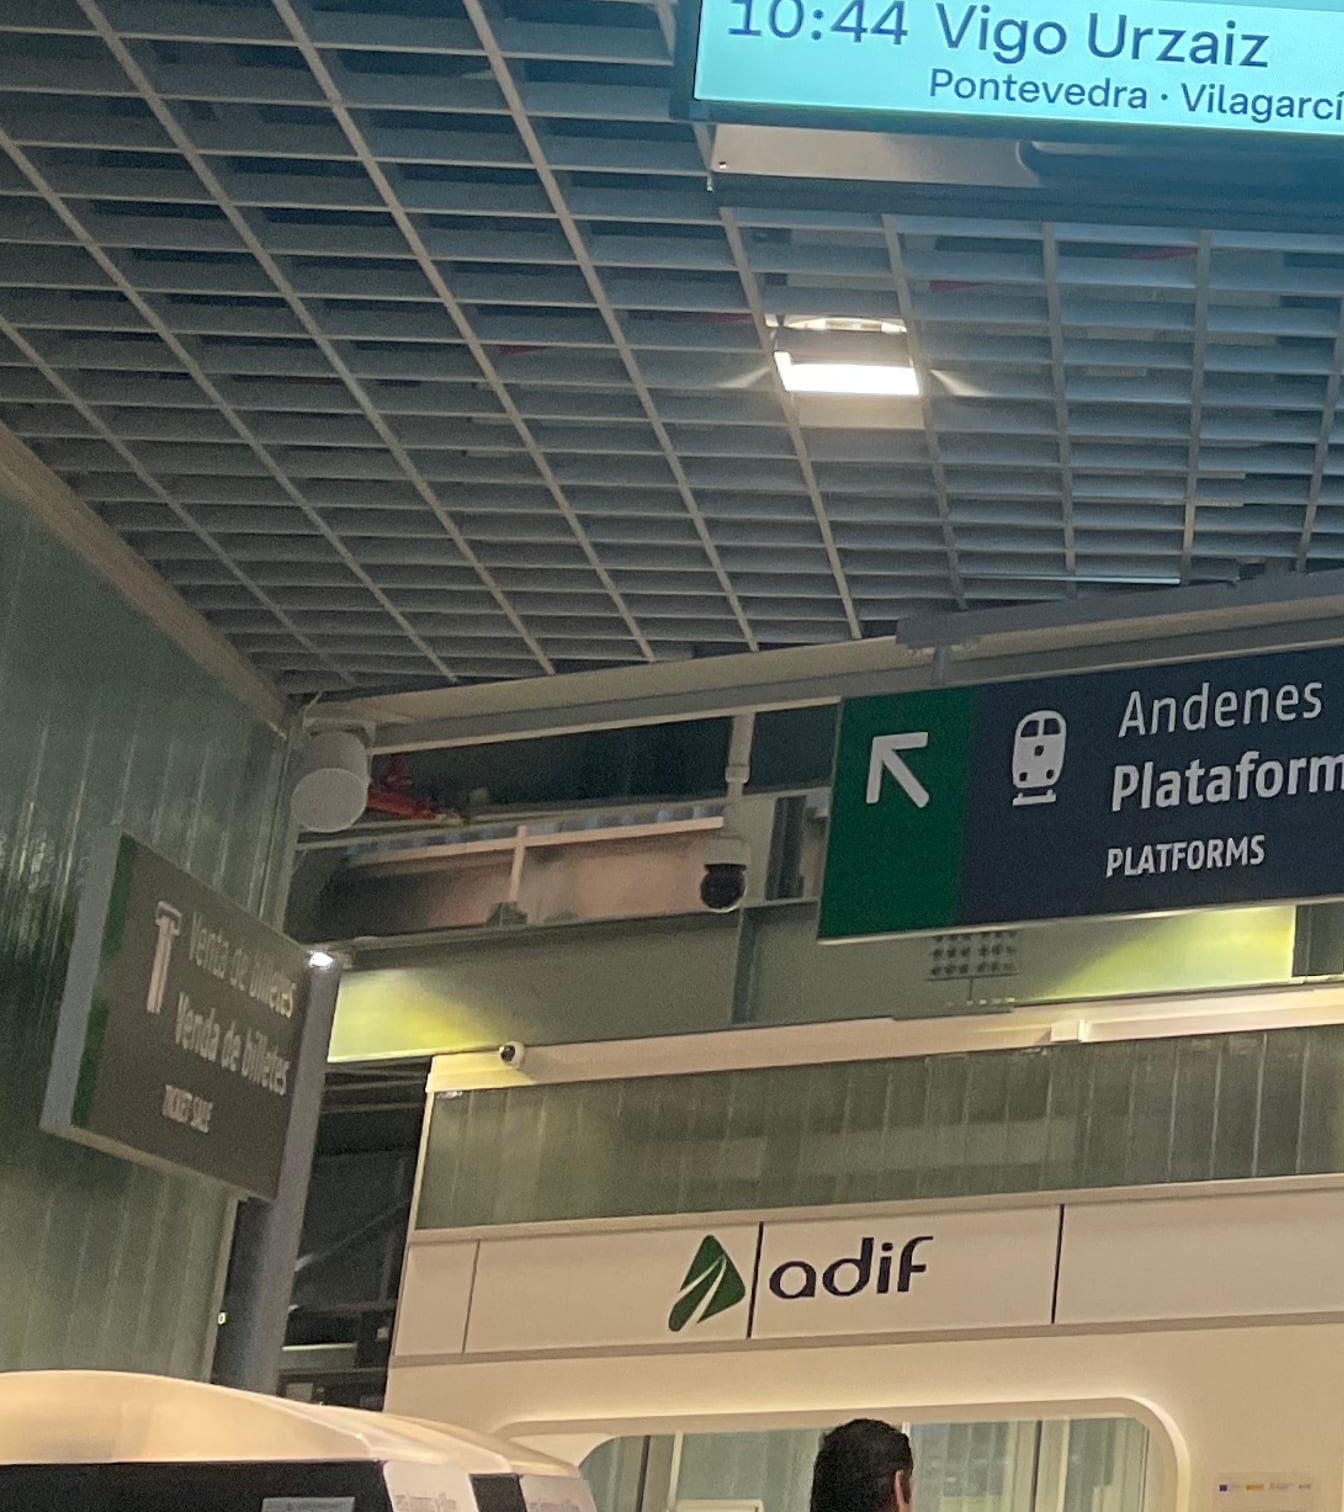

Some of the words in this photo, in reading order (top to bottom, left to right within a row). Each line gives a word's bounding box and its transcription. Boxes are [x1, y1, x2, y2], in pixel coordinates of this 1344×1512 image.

[936, 2, 1068, 65] Vigo
[1088, 12, 1270, 68] Urzaiz
[930, 68, 1148, 110] Pontevedra
[1118, 682, 1323, 738] Andenes
[1106, 834, 1265, 878] PLATFORMS
[769, 1235, 934, 1300] adif
